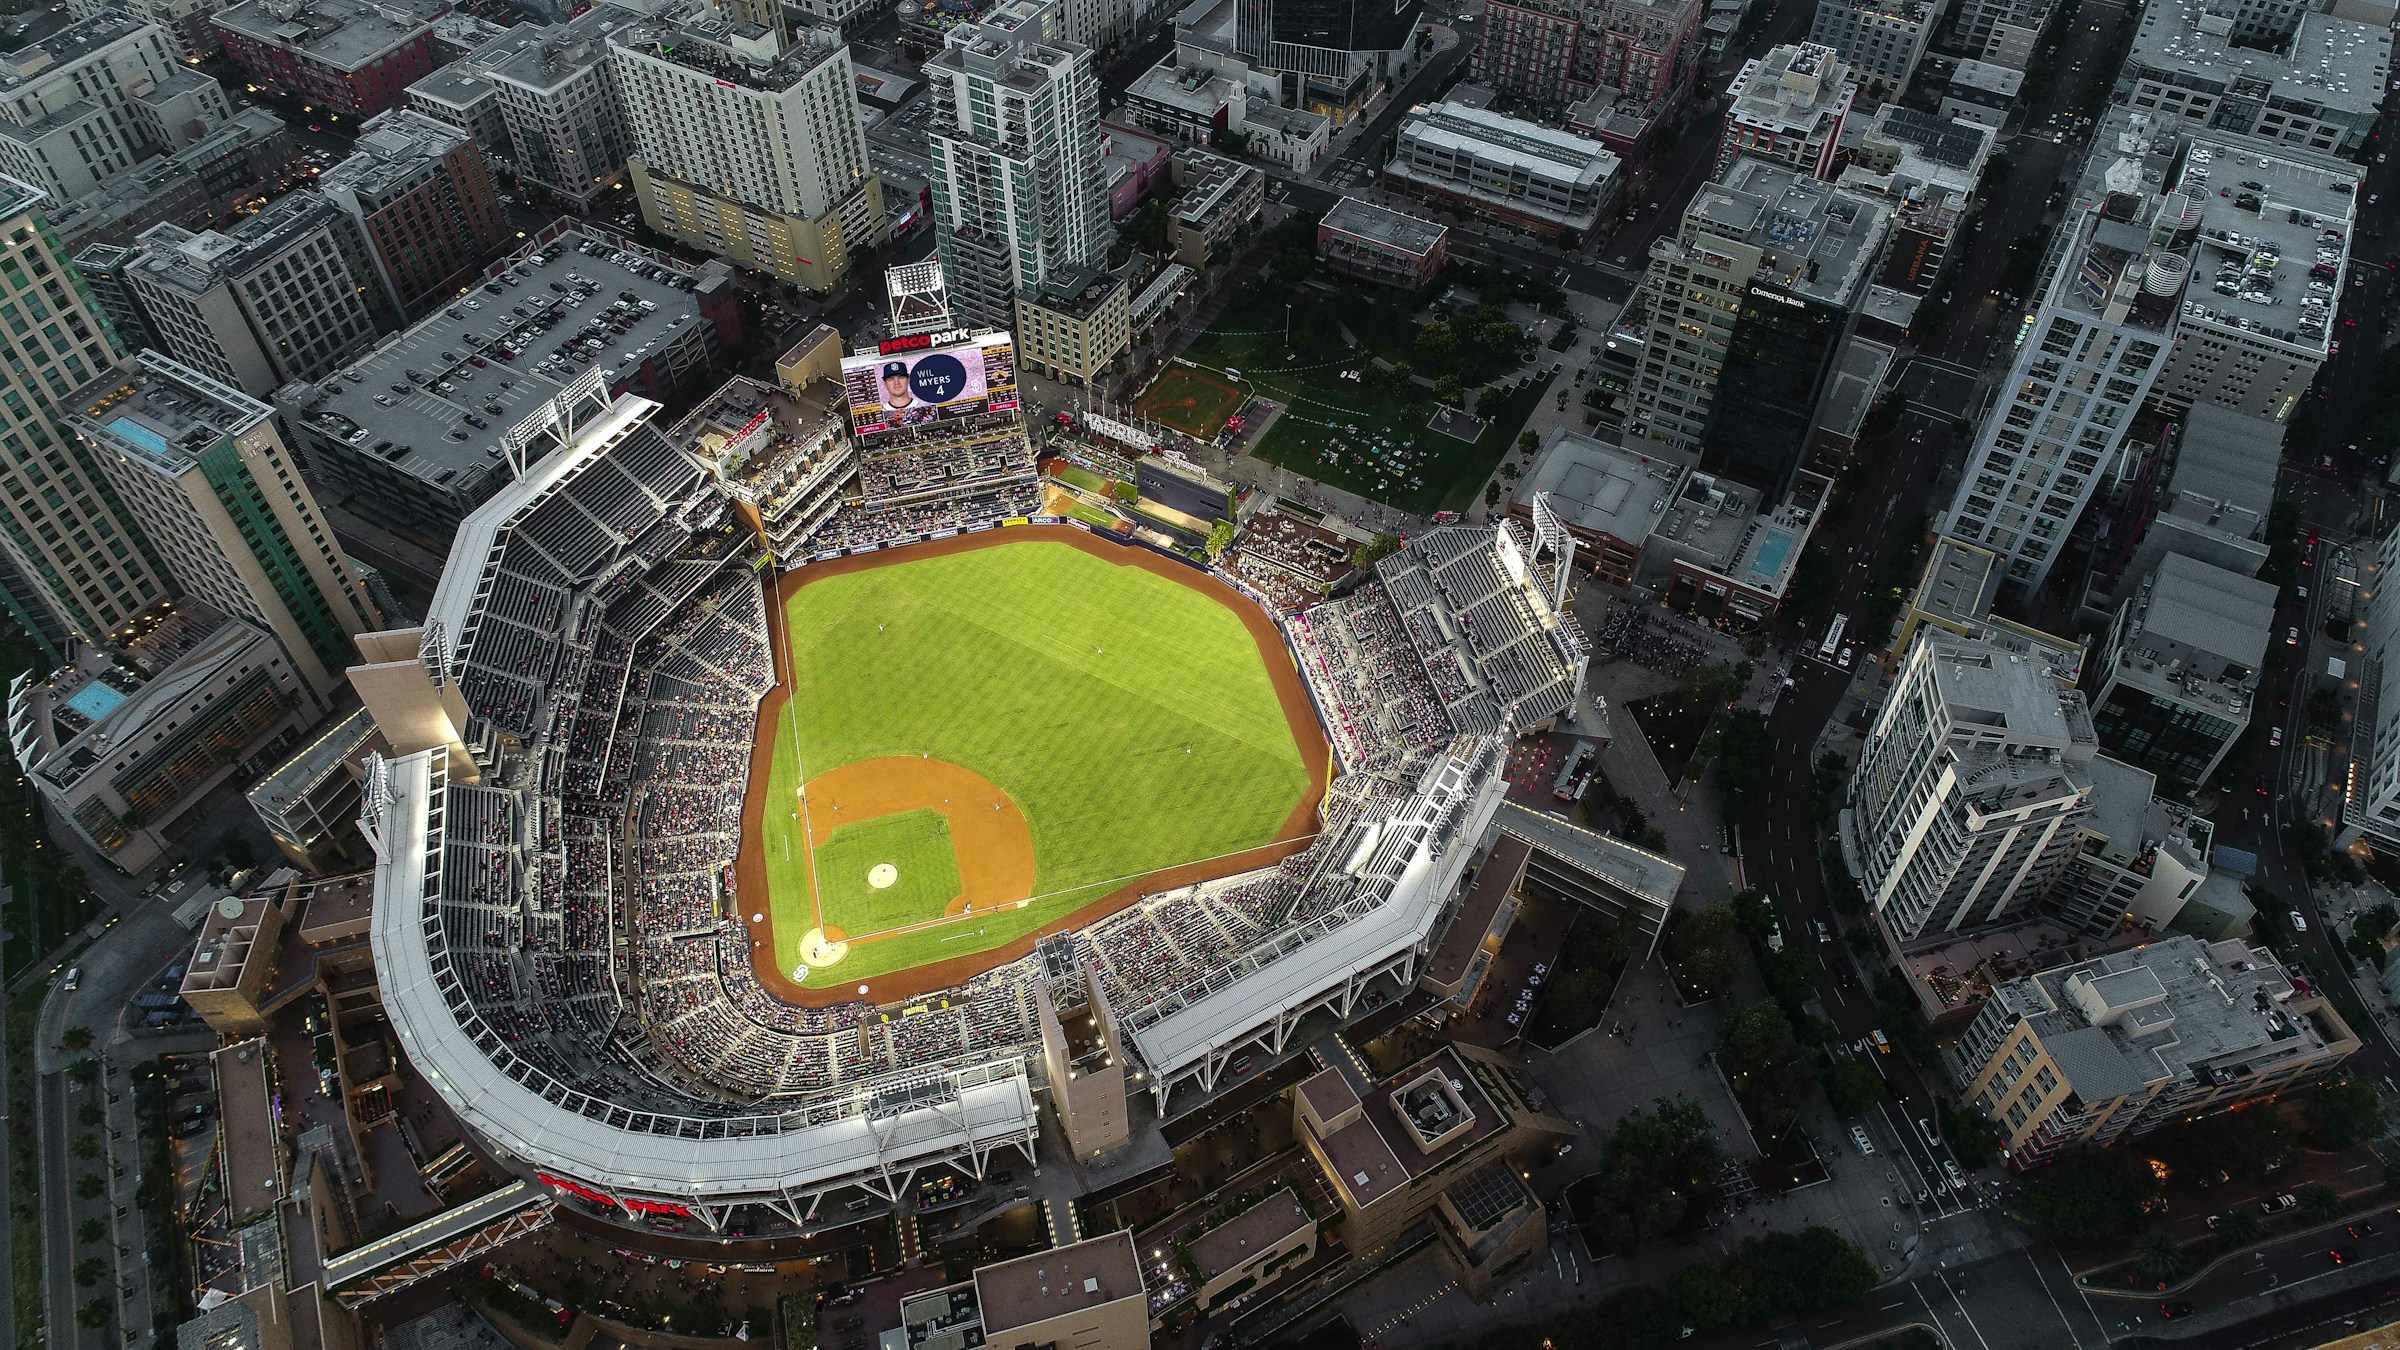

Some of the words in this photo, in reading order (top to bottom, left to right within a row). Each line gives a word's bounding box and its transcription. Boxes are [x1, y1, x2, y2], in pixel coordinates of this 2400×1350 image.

[1907, 240, 1929, 281] URBANA
[1786, 297, 1806, 308] Bank
[917, 370, 934, 378] WIL
[919, 376, 951, 388] MYERS
[936, 386, 945, 396] 4
[754, 473, 784, 500] WESTERN
[786, 455, 809, 474] METAL
[807, 434, 834, 455] SUPPLY
[932, 530, 957, 538] GEICO
[785, 560, 807, 572] ASML
[538, 1172, 616, 1207] petco
[624, 1199, 693, 1217] park
